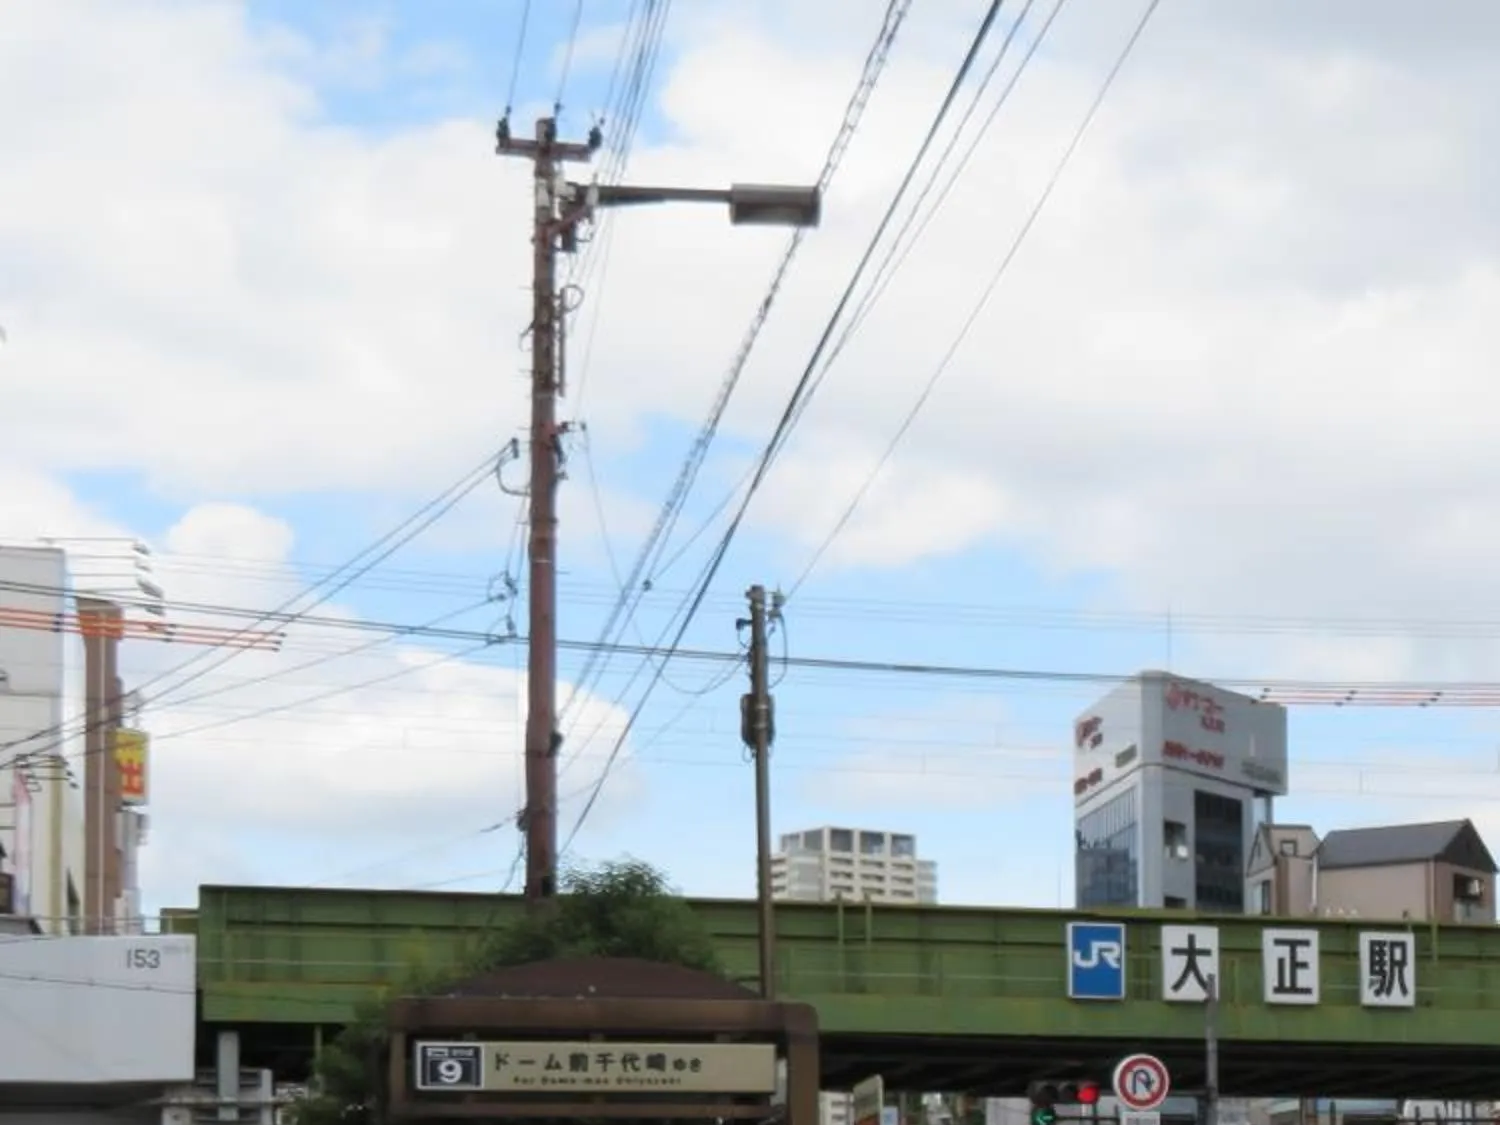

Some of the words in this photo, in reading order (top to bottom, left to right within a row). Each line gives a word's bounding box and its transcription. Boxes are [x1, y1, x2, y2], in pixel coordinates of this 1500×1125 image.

[127, 949, 161, 969] 153
[1074, 941, 1121, 969] JR
[1171, 933, 1408, 998] 大正駅
[439, 1059, 462, 1084] 9
